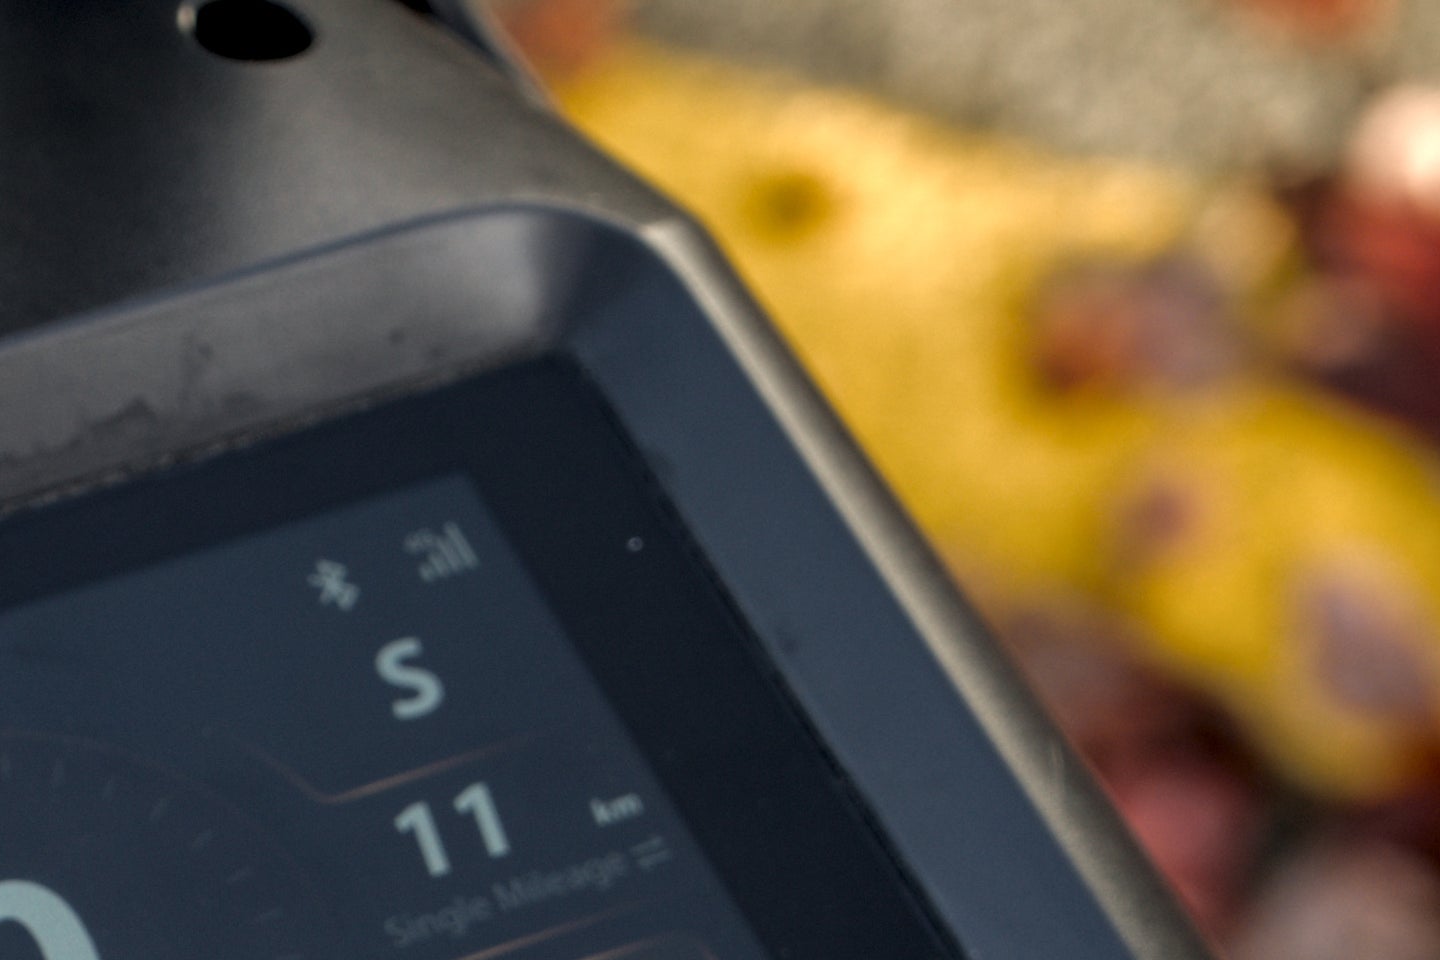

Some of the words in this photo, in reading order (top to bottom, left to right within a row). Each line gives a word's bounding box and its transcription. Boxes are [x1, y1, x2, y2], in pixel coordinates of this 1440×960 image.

[375, 637, 444, 720] S
[394, 782, 510, 877] 11
[590, 793, 643, 826] km
[382, 896, 492, 949] Single
[490, 851, 628, 912] Mileage
